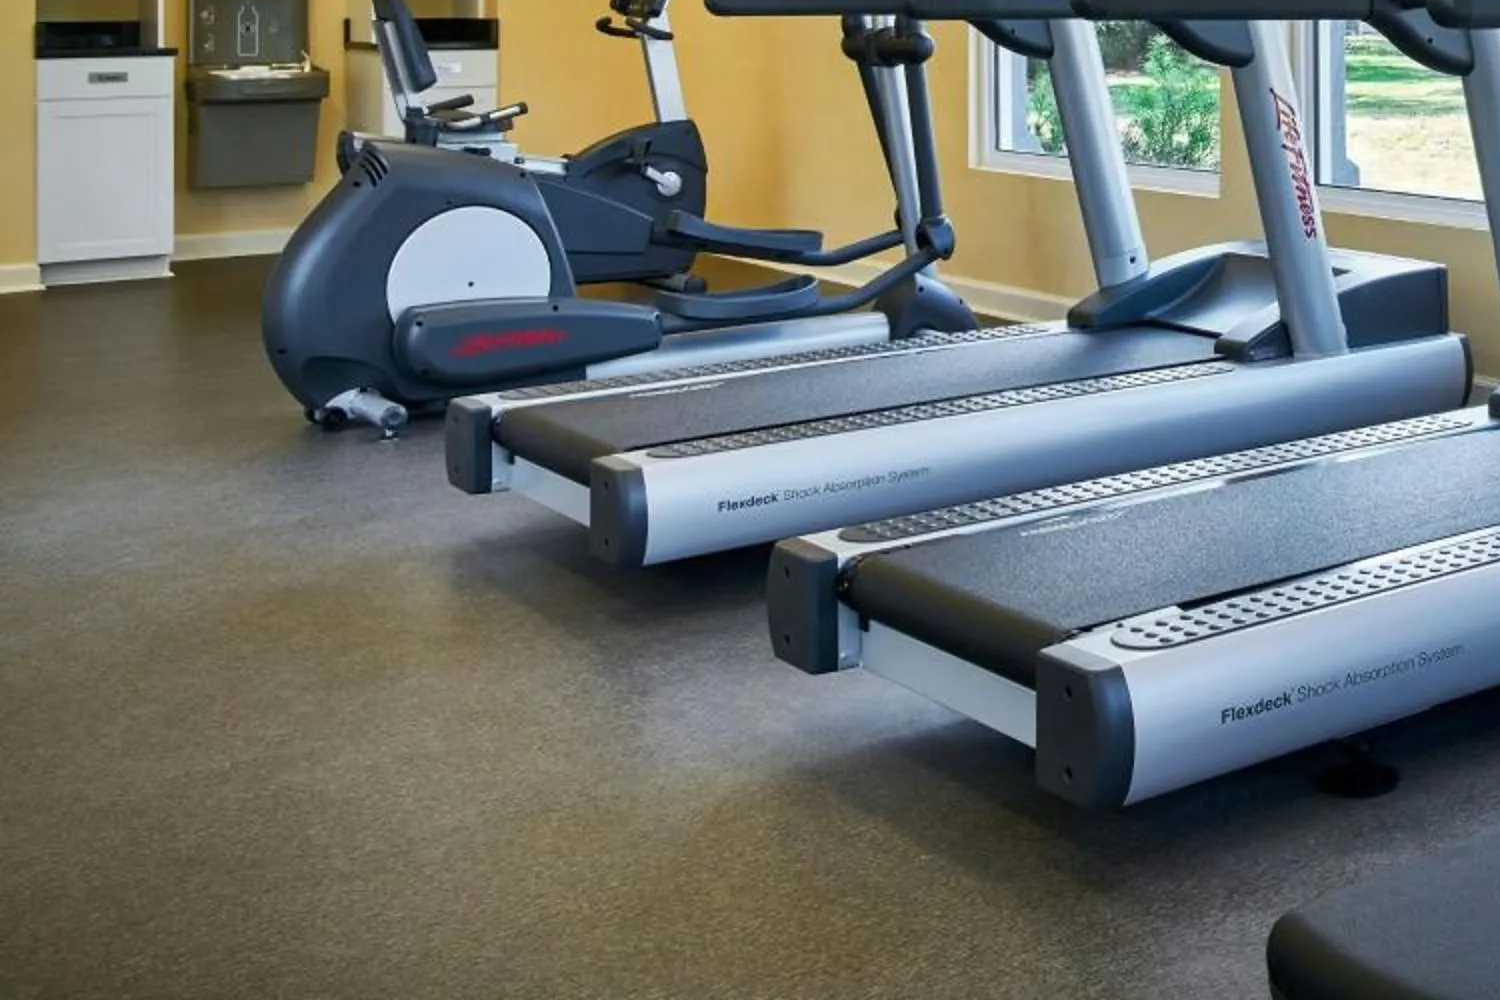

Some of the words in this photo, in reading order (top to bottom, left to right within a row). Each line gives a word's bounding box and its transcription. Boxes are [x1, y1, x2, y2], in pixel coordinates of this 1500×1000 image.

[1281, 142, 1317, 239] Fitness
[717, 493, 779, 513] Flexdeck
[783, 484, 821, 501] Shock
[822, 474, 886, 494] Absorption
[888, 466, 930, 484] System
[1220, 691, 1292, 724] Flexdeck
[1297, 680, 1341, 703] Shock
[1344, 658, 1415, 687] Absorption
[1417, 643, 1464, 667] System
